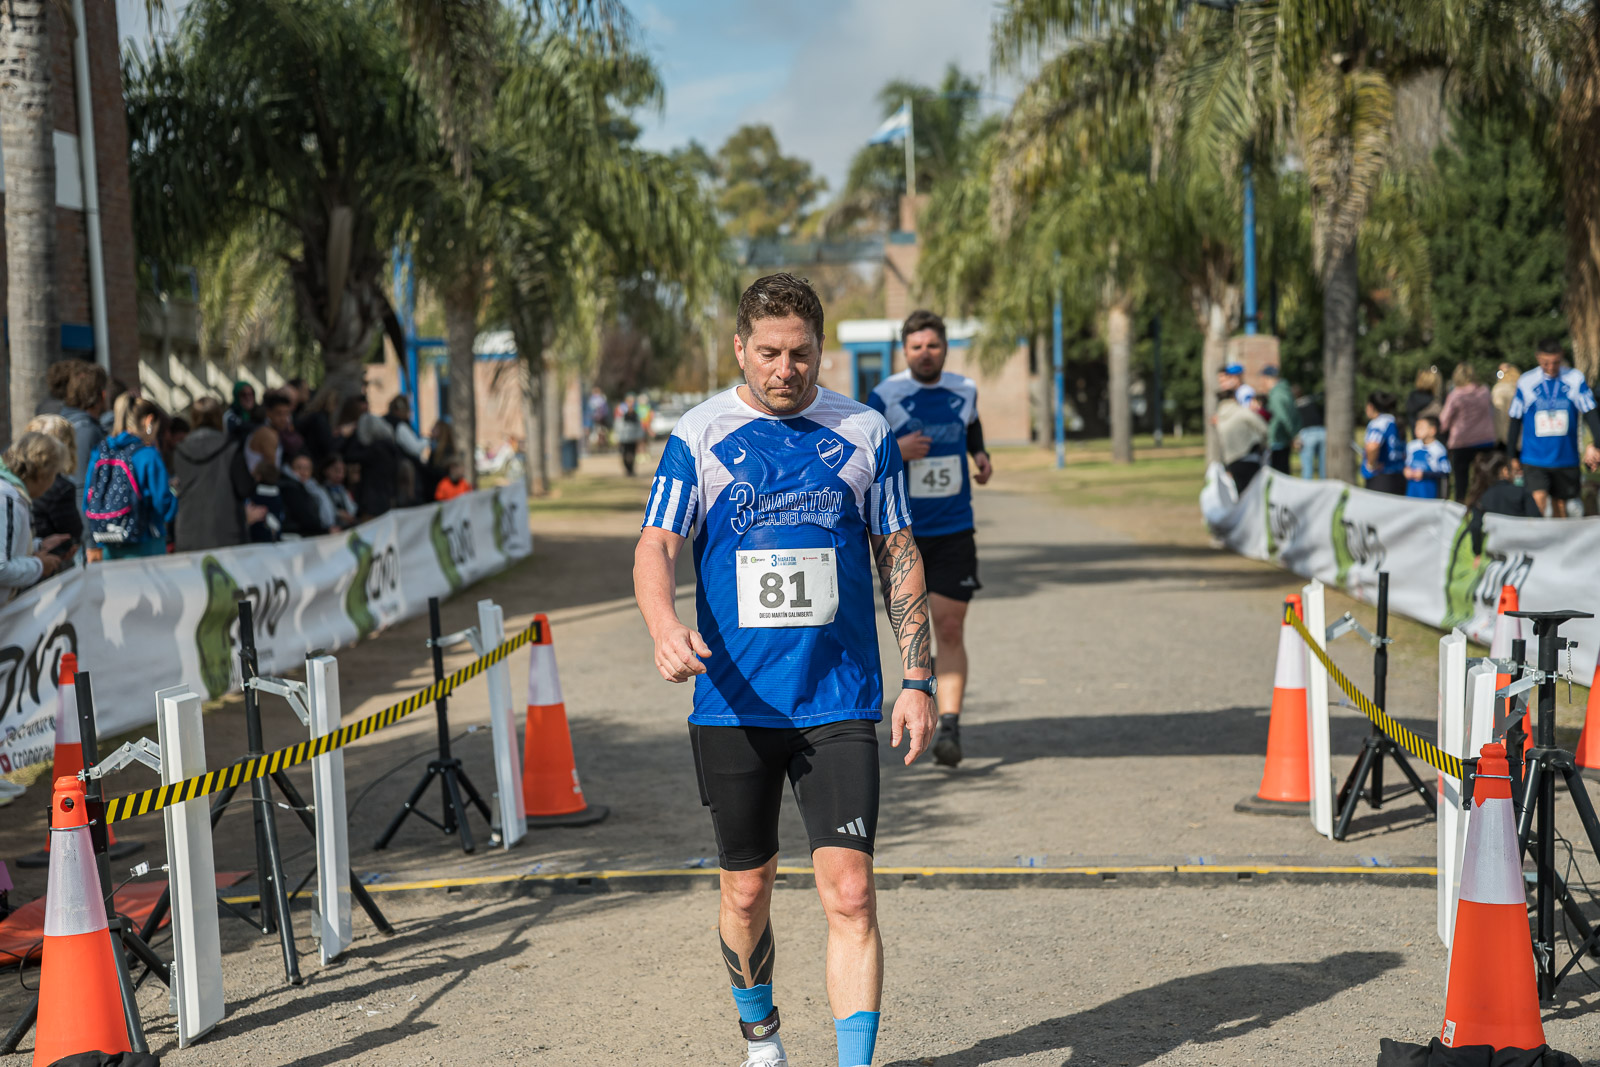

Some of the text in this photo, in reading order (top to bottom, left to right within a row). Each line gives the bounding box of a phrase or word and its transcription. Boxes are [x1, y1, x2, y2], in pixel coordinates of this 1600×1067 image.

[922, 468, 951, 487] 45
[729, 482, 755, 535] 3
[758, 487, 843, 513] MARATÓN
[770, 554, 778, 567] 3
[759, 571, 812, 609] 81
